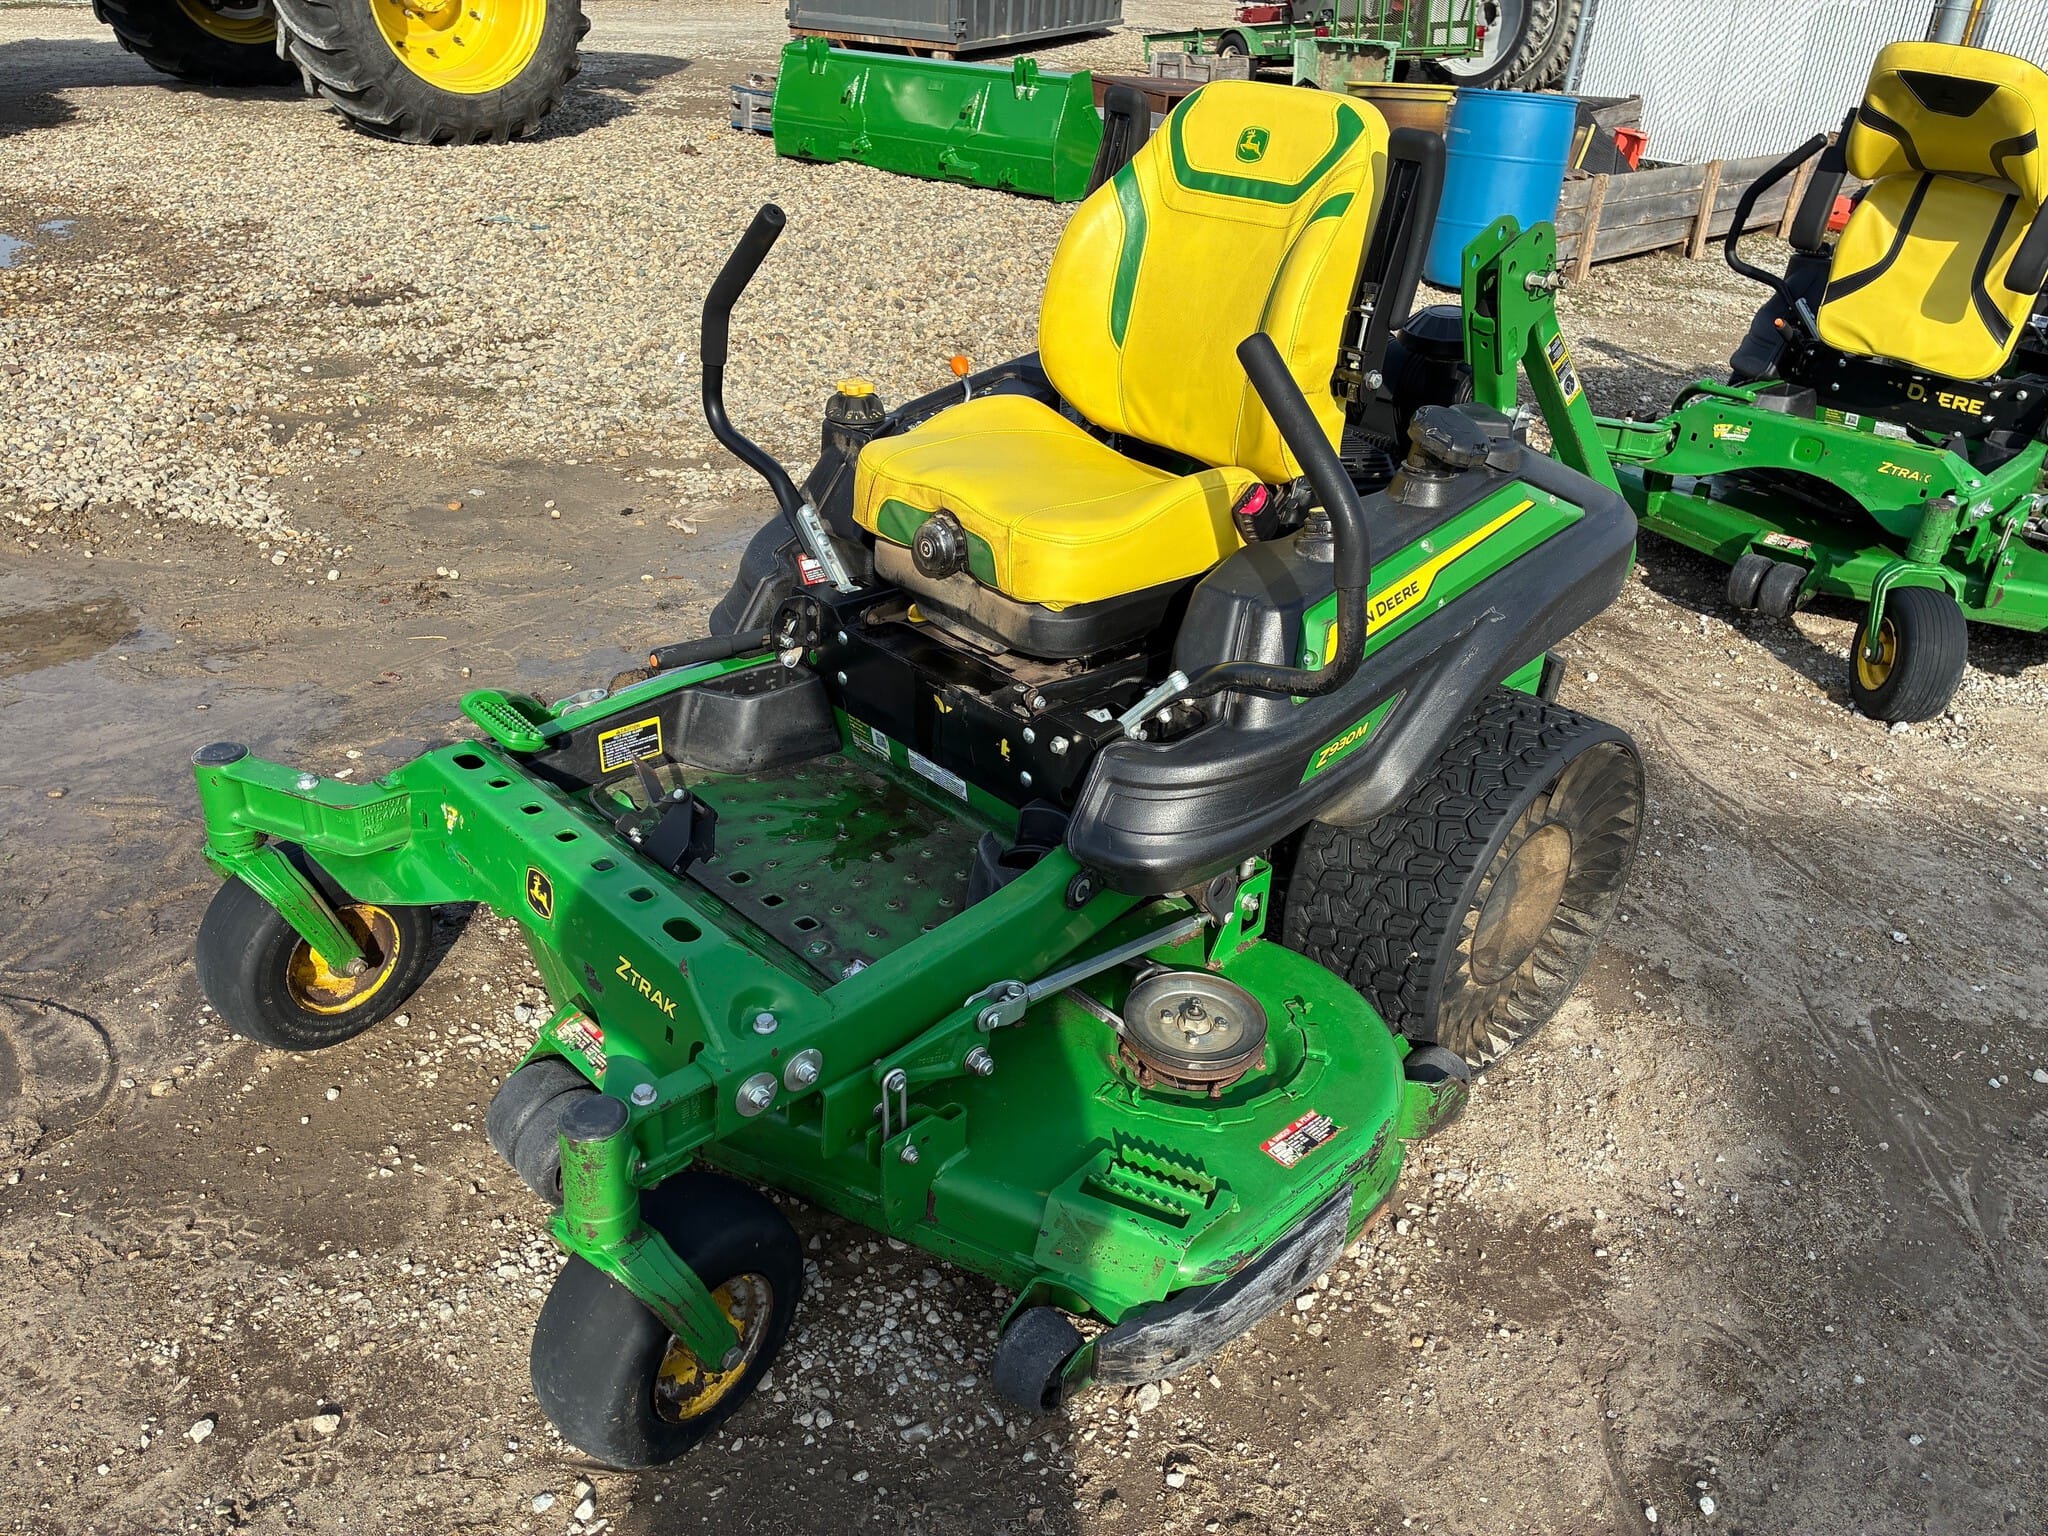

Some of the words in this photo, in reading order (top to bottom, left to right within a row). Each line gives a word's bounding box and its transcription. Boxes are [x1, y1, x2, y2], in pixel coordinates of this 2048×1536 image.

[1907, 383, 1985, 415] DERE
[1376, 581, 1419, 617] DEERE
[1316, 722, 1369, 769] Z930M
[615, 955, 678, 1020] ZTRAK
